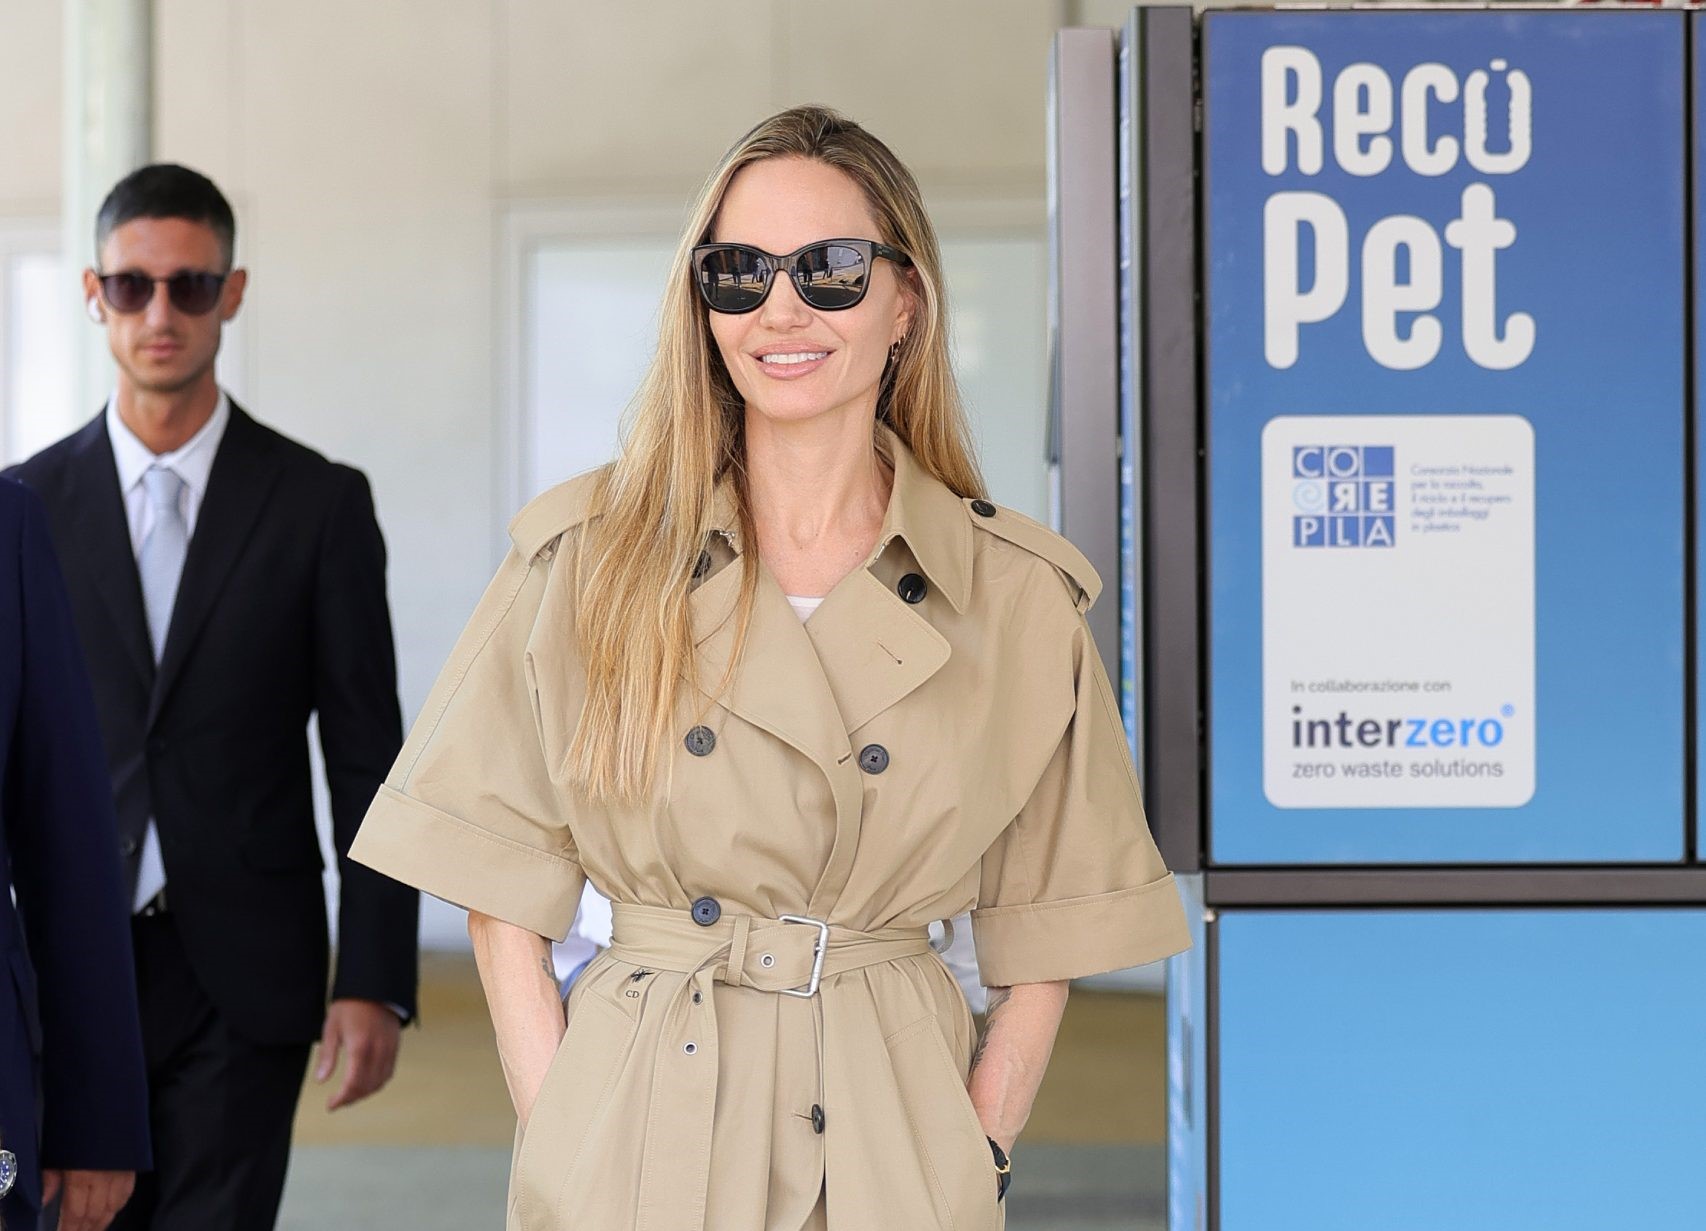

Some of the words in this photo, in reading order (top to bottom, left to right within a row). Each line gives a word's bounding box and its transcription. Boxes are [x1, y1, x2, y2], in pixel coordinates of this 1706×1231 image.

[1263, 182, 1536, 371] Pet
[1300, 518, 1393, 546] PLA
[1290, 680, 1305, 693] In
[1307, 680, 1420, 693] collaborazione
[1422, 682, 1452, 693] con
[1292, 762, 1336, 779] zero
[1341, 760, 1403, 778] waste
[1409, 758, 1504, 778] solutions
[625, 989, 640, 999] CD
